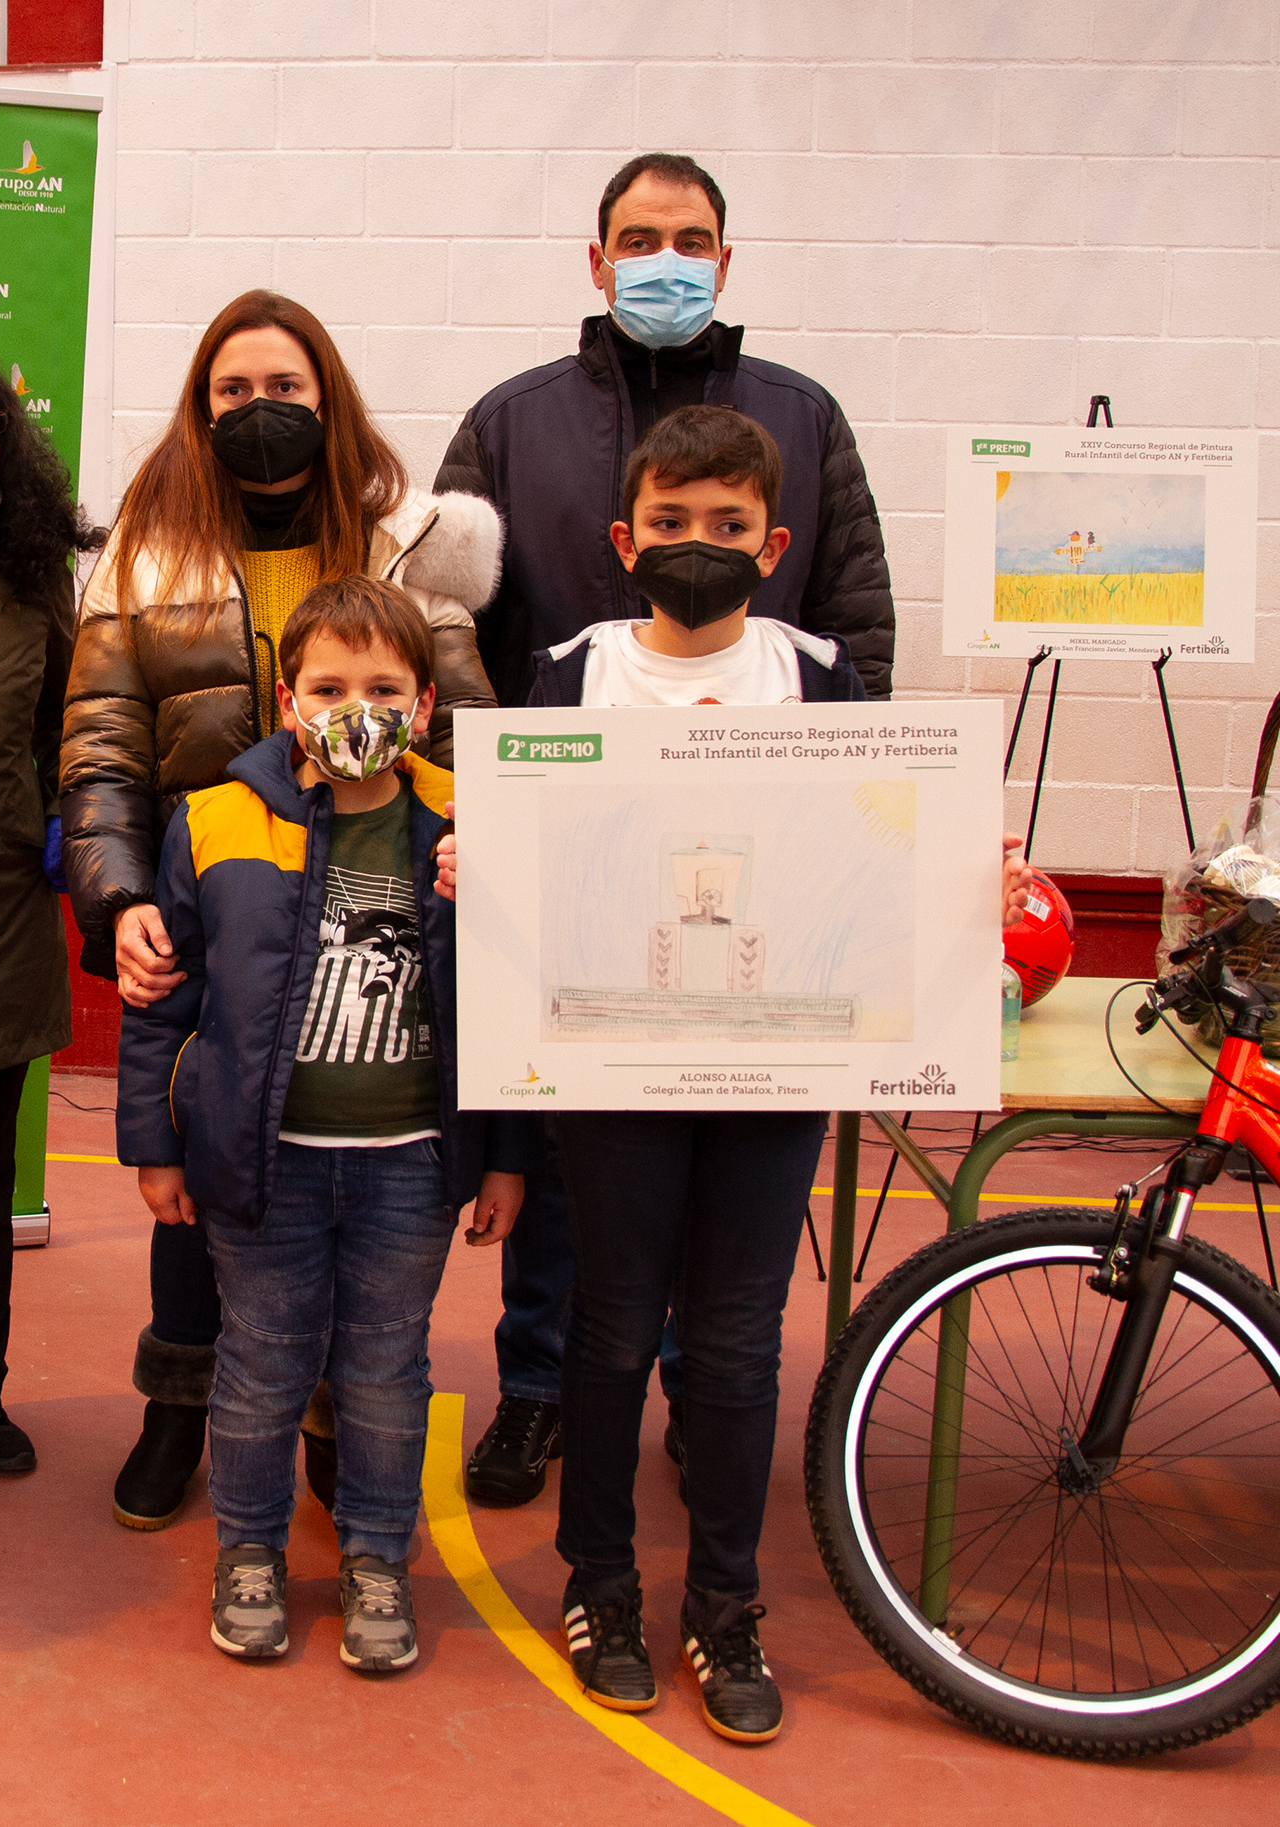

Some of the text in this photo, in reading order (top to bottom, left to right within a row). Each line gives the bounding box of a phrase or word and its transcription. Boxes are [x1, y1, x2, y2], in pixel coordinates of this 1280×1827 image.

[37, 176, 63, 192] AN
[25, 398, 51, 413] AN
[990, 443, 1027, 453] PREMIO
[1081, 441, 1102, 449] XXIV
[1104, 441, 1146, 450] Concurso
[1148, 442, 1186, 451] Regional
[1200, 443, 1233, 451] Pintura
[1064, 450, 1088, 458] Rural
[1090, 451, 1122, 459] Infantil
[1139, 452, 1166, 461] Grupo
[1183, 454, 1190, 462] y
[1191, 453, 1233, 461] Fertiberia
[967, 642, 988, 650] Grupo
[1075, 645, 1105, 653] Francisco
[1180, 644, 1230, 654] Fertiberia
[688, 726, 958, 742] XXIV Concurso Regional de Pintura
[529, 742, 595, 758] PREMIO
[660, 744, 958, 760] Rural Infantil del Grupo AN y Fertiberia
[679, 1073, 772, 1082] ALONSO ALIAGA
[500, 1086, 556, 1098] Grupo AN
[643, 1085, 809, 1097] Colegio Juan de Palafox, Fitero
[870, 1079, 956, 1095] Fertiberia
